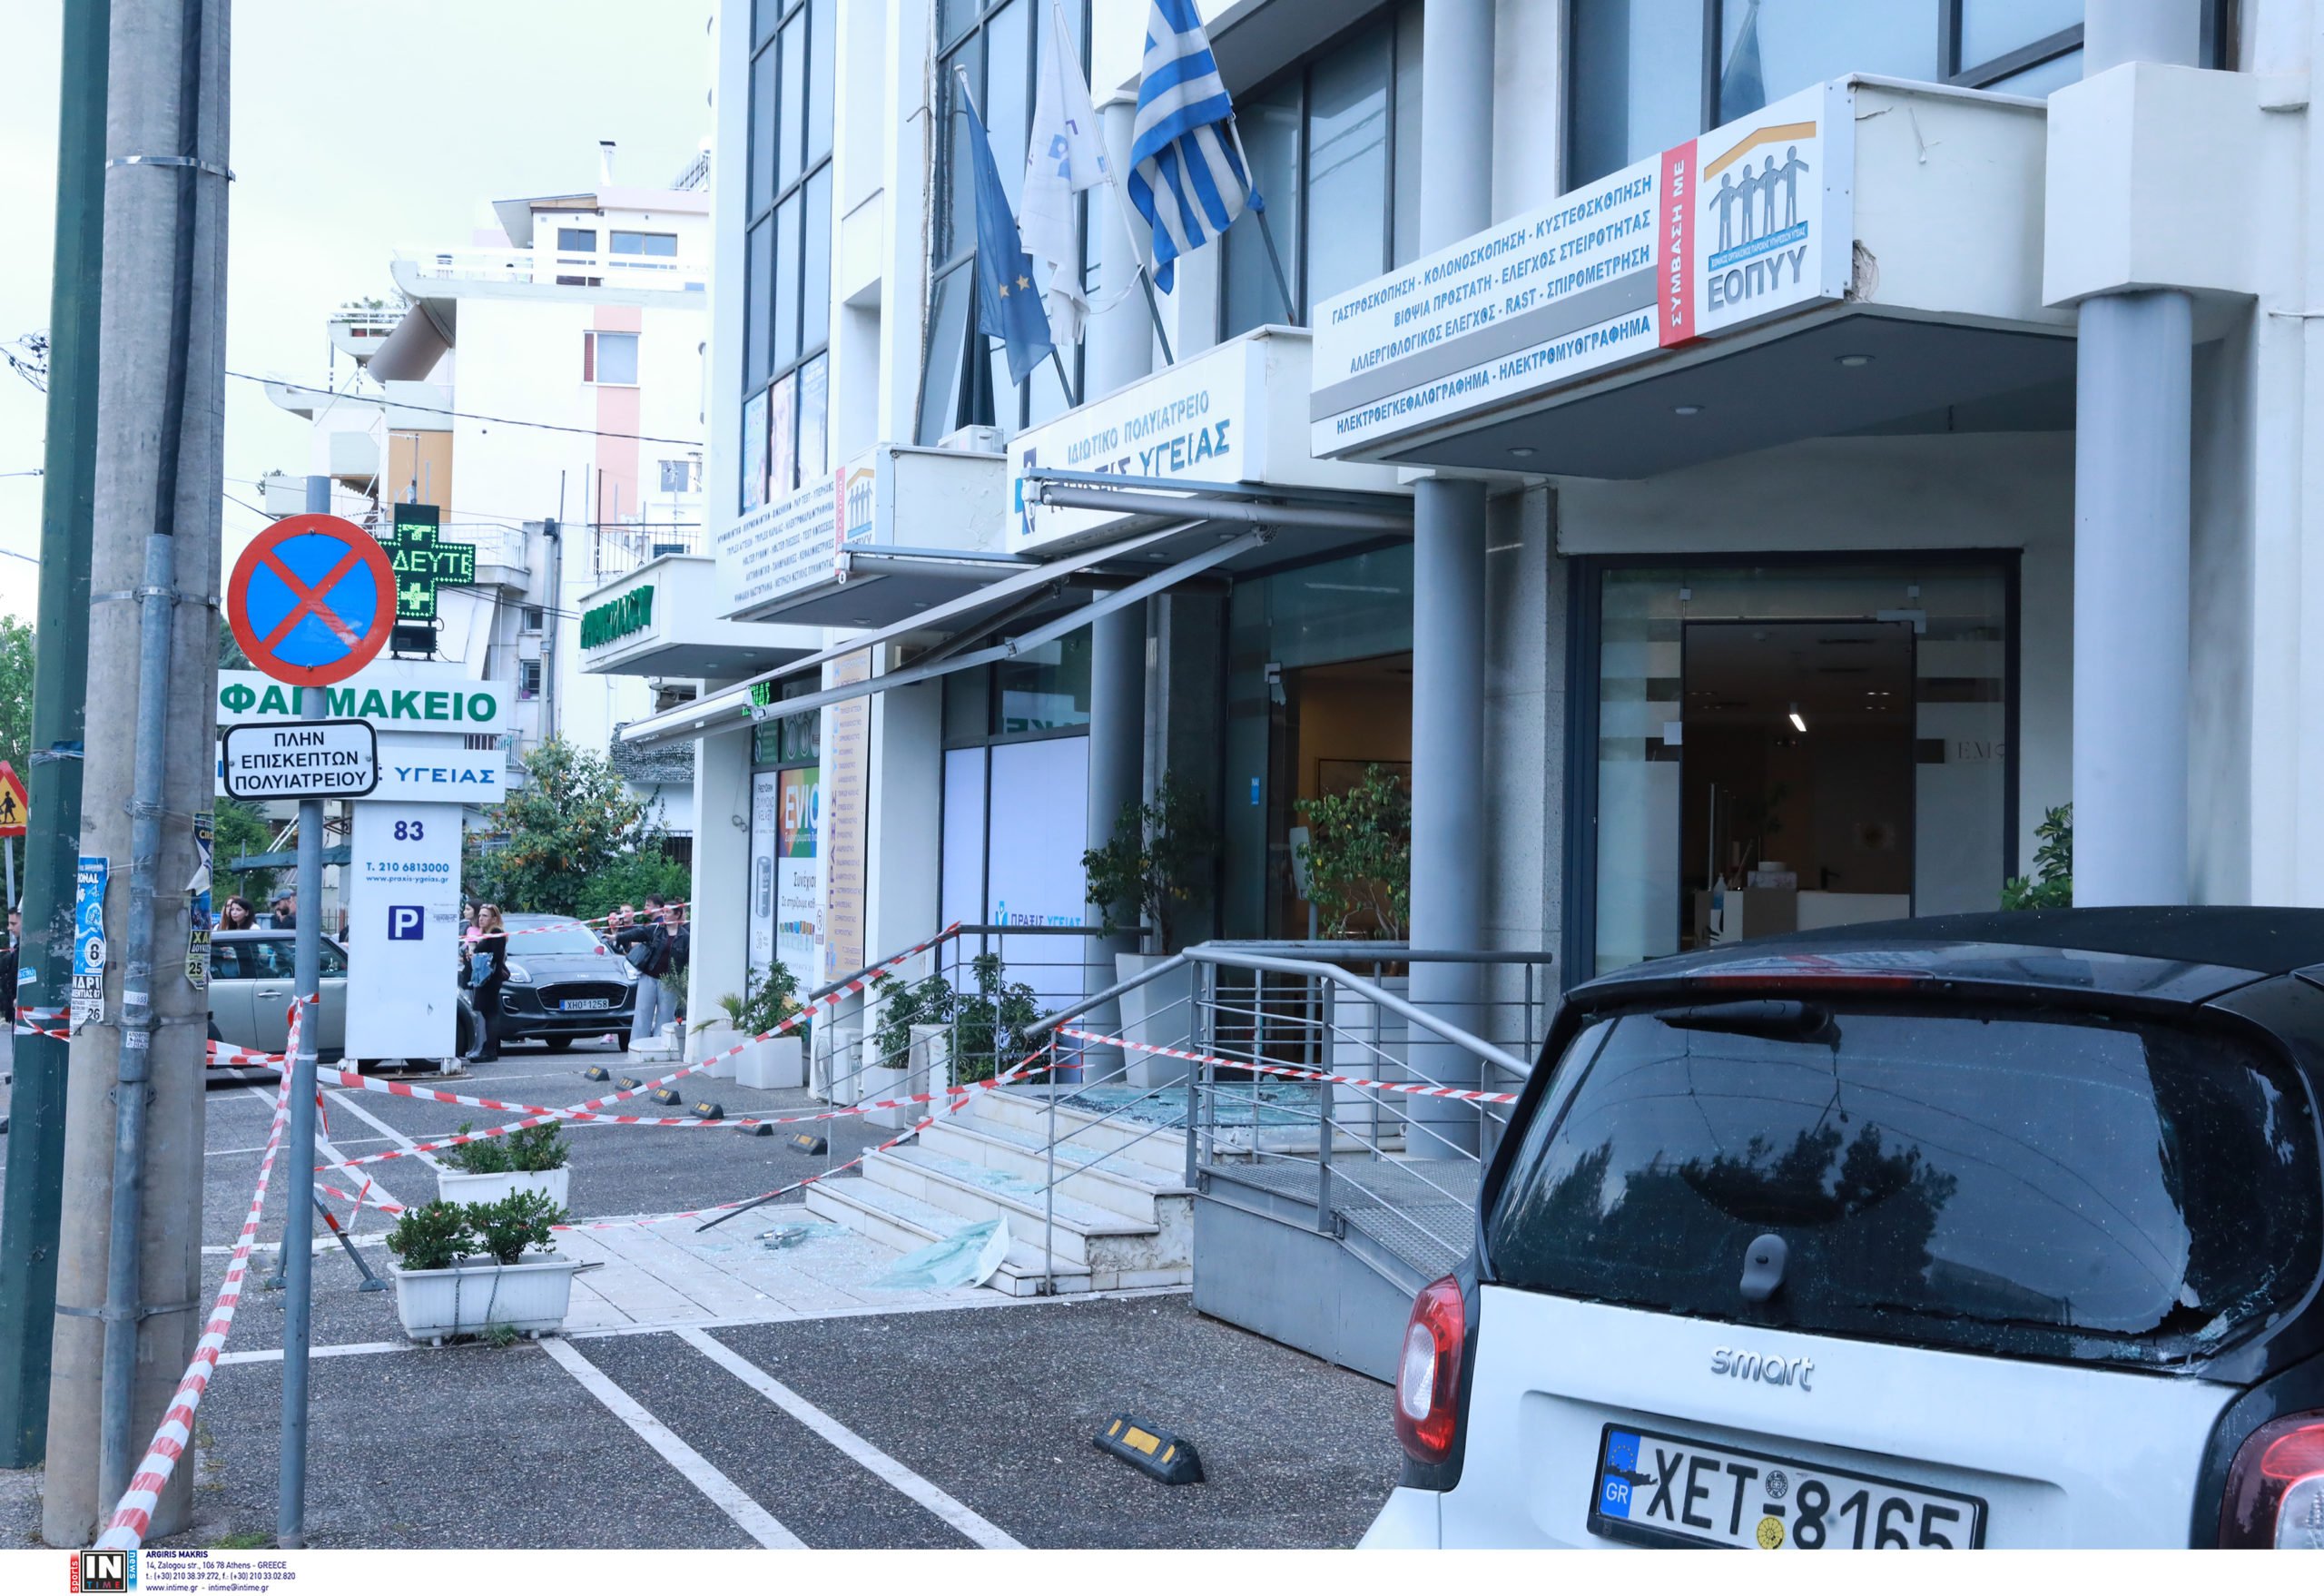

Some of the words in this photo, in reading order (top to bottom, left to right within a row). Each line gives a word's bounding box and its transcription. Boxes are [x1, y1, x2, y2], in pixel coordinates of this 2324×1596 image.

[1672, 160, 1685, 195] ΜΕ
[1332, 277, 1415, 325] ΓΑΣΤΡΟΣΚΟΠΗΣΗ
[1424, 230, 1526, 286] ΚΟΛΟΝΟΣΚΟΠΗΣΗ
[1536, 174, 1652, 240] ΚΥΣΤΕΟΣΚΟΠΗΣΗ
[1393, 300, 1431, 328] ΒΙΟΨΙΑ
[1433, 273, 1492, 316] ΠΡΟΣΤΑΤΗ
[1502, 252, 1556, 286] ΕΛΕΓΧΟΣ
[1560, 210, 1651, 261] ΣΤΕΙΡΟΤΗΤΑΣ
[1672, 204, 1682, 325] ΣΥΜΒΑΣΗ
[1708, 245, 1807, 312] ΕΟΠΥΥ
[1350, 325, 1443, 375] ΑΛΛΕΡΓΙΟΛΟΓΙΚΟΣ
[1444, 302, 1496, 339] ΕΛΕΓΧΟΣ
[1505, 288, 1536, 313] RAST
[1547, 244, 1650, 299] ΣΠΙΡΟΜΕΤΡΗΣΗ
[1336, 368, 1490, 436] ΗΛΕΚΤΡΟΕΓΚΕΦΑΛΟΓΡΑΦΗΜΑ
[1499, 316, 1651, 381] ΗΛΕΚΤΡΟΜΥΟΓΡΑΦΗΜΑ
[1068, 428, 1118, 466] ΙΔΙΩΤΙΚΟ
[1124, 390, 1209, 444] ΠΟΛΥΙΑΤΡΕΙΟ
[1139, 419, 1230, 478] ΥΓΕΙΑΣ
[274, 731, 324, 747] ΠΛΗΝ
[241, 751, 359, 770] ΕΠΙΣΚΕΠΤΩΝ
[234, 772, 367, 790] ΠΟΛΥΙΑΤΡΕΙΟΥ
[393, 767, 496, 784] ΥΓΕΙΑΣ
[394, 821, 424, 841] 83
[379, 862, 399, 872] 210
[402, 862, 449, 872] 6813000
[366, 875, 448, 884] www.praxis-ygeias.gr
[395, 909, 419, 937] P
[1010, 913, 1044, 927] ΠΡΑΞΙΣ
[189, 961, 202, 974] 25
[88, 1008, 101, 1020] 26
[588, 1000, 607, 1010] 1258
[1711, 1345, 1816, 1392] smart
[1606, 1484, 1630, 1504] GR
